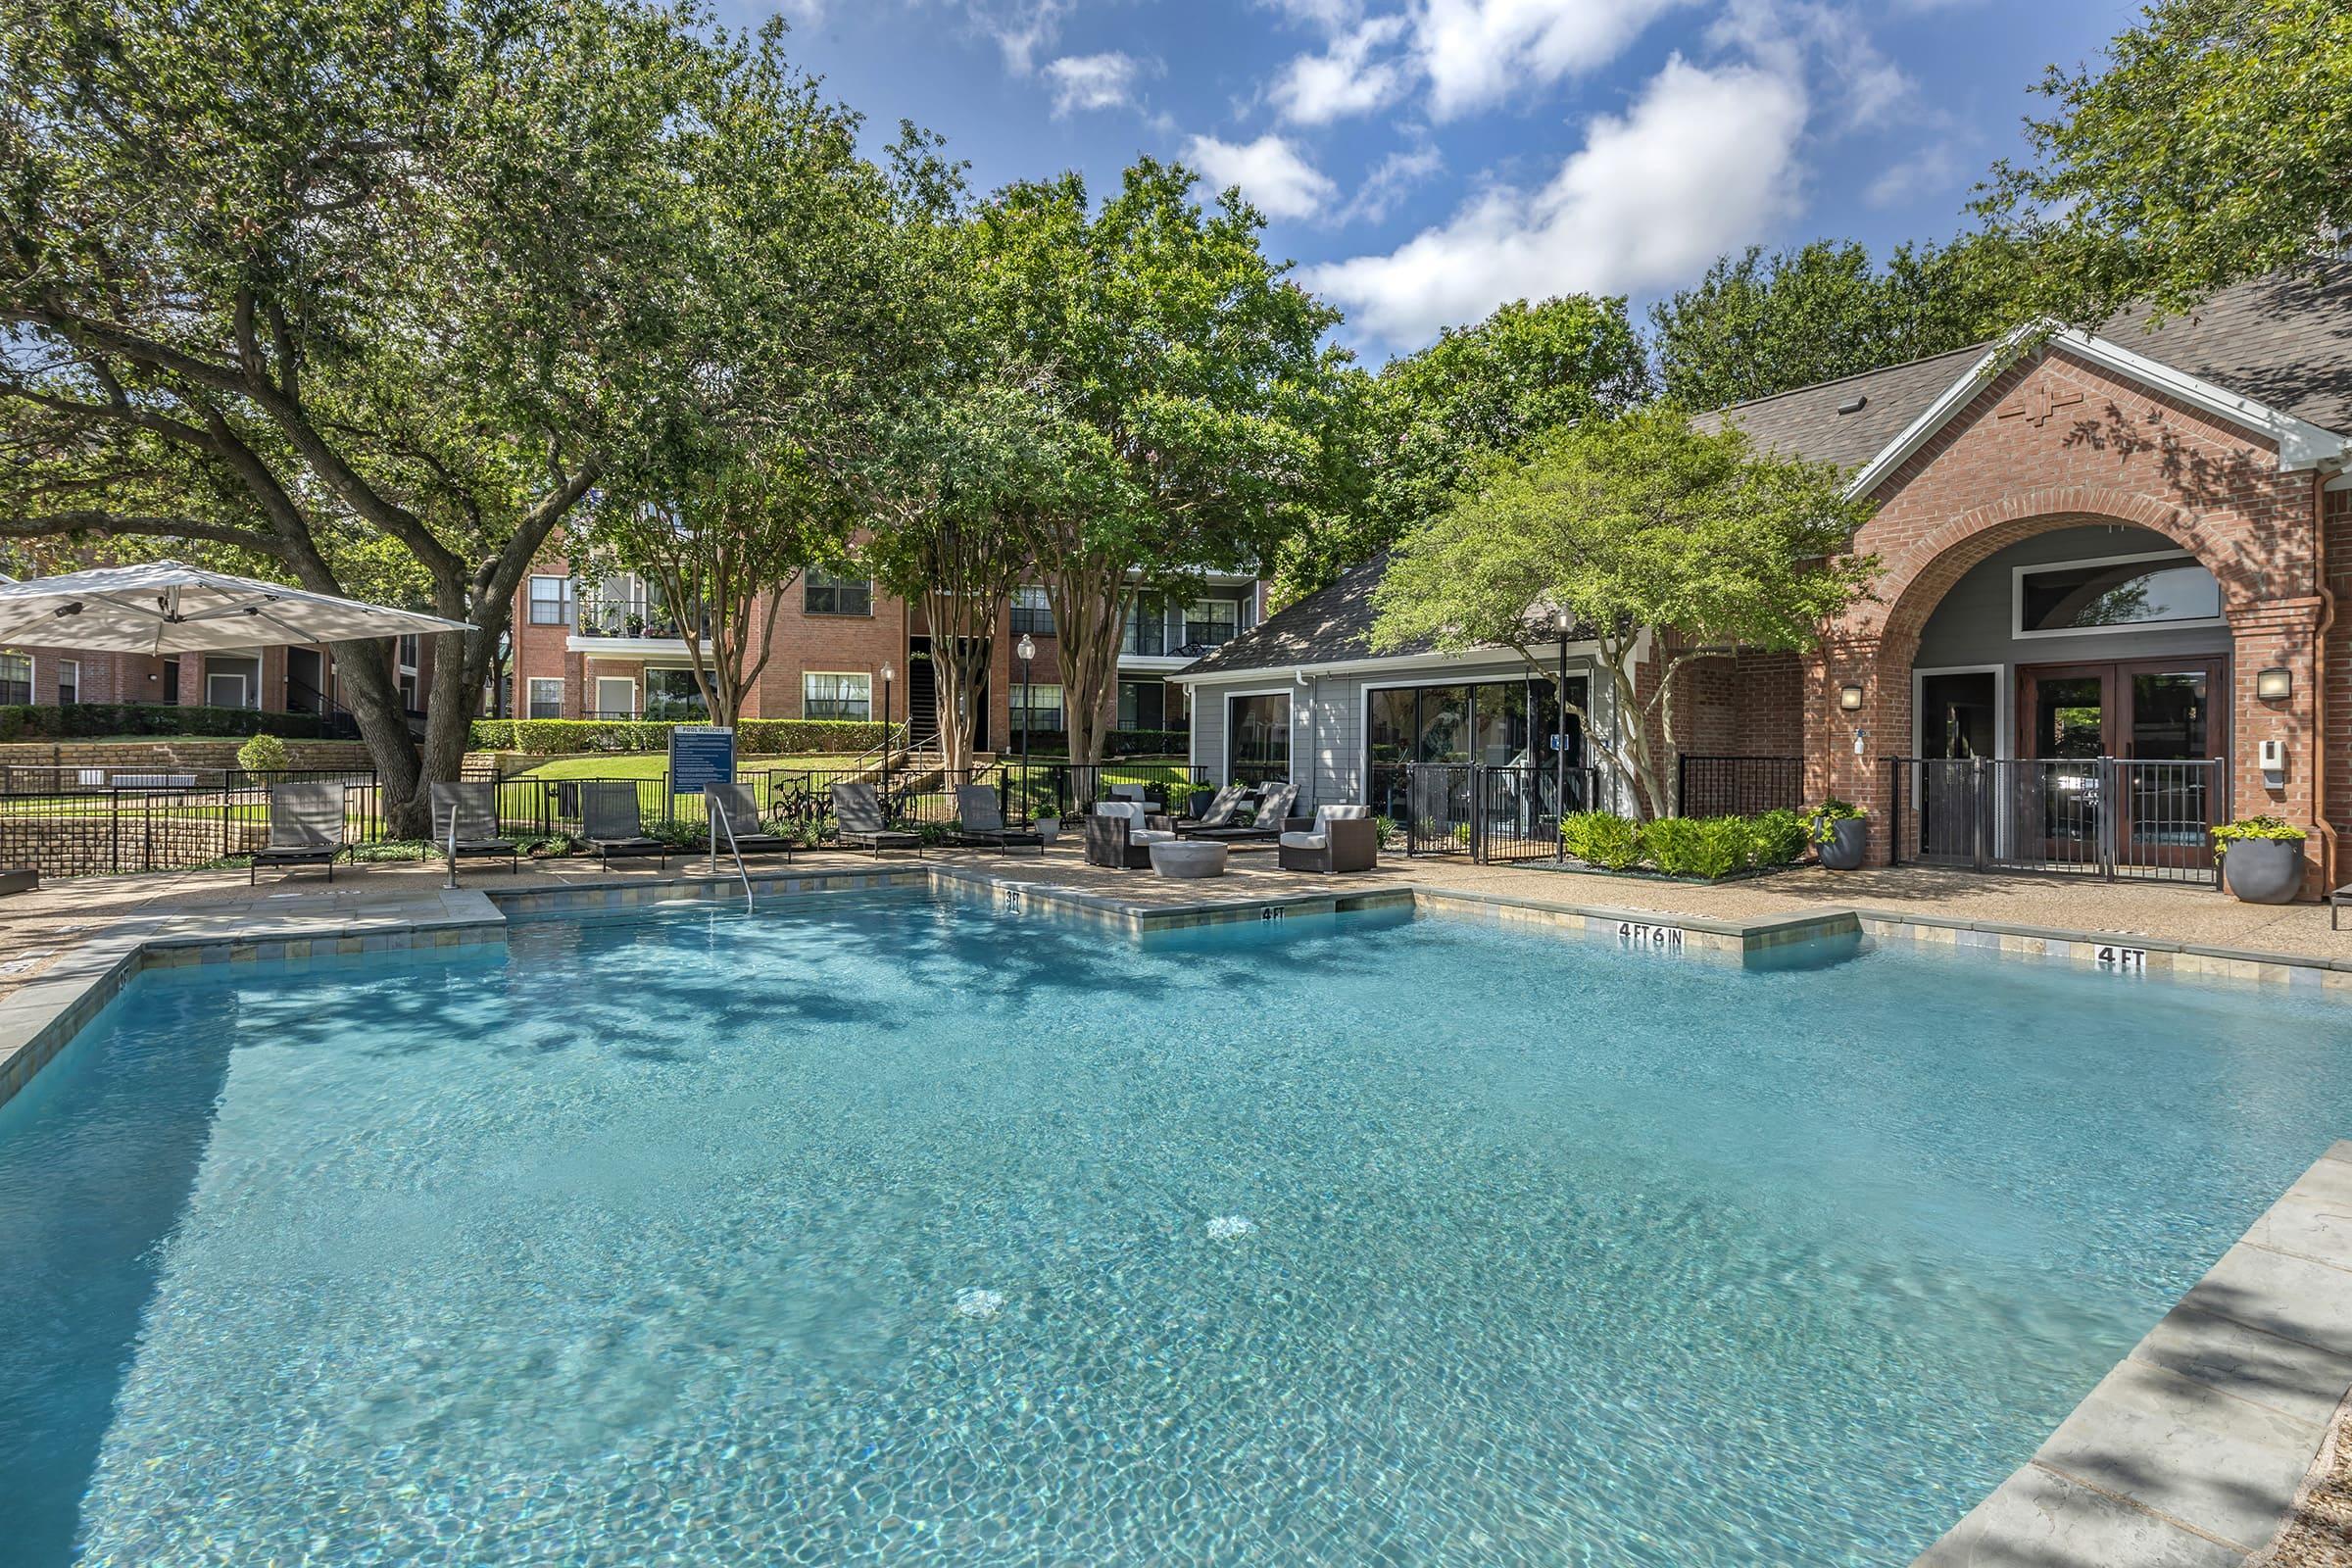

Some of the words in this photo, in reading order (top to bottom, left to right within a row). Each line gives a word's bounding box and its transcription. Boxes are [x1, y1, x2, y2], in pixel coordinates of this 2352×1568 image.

[1262, 907, 1271, 920] 4
[1273, 906, 1284, 919] FT
[1619, 923, 1631, 937] 4
[1634, 924, 1649, 939] FT
[1652, 928, 1664, 942] 6
[1668, 929, 1682, 944] IN
[2098, 947, 2116, 962] 4
[2121, 949, 2144, 966] FT
